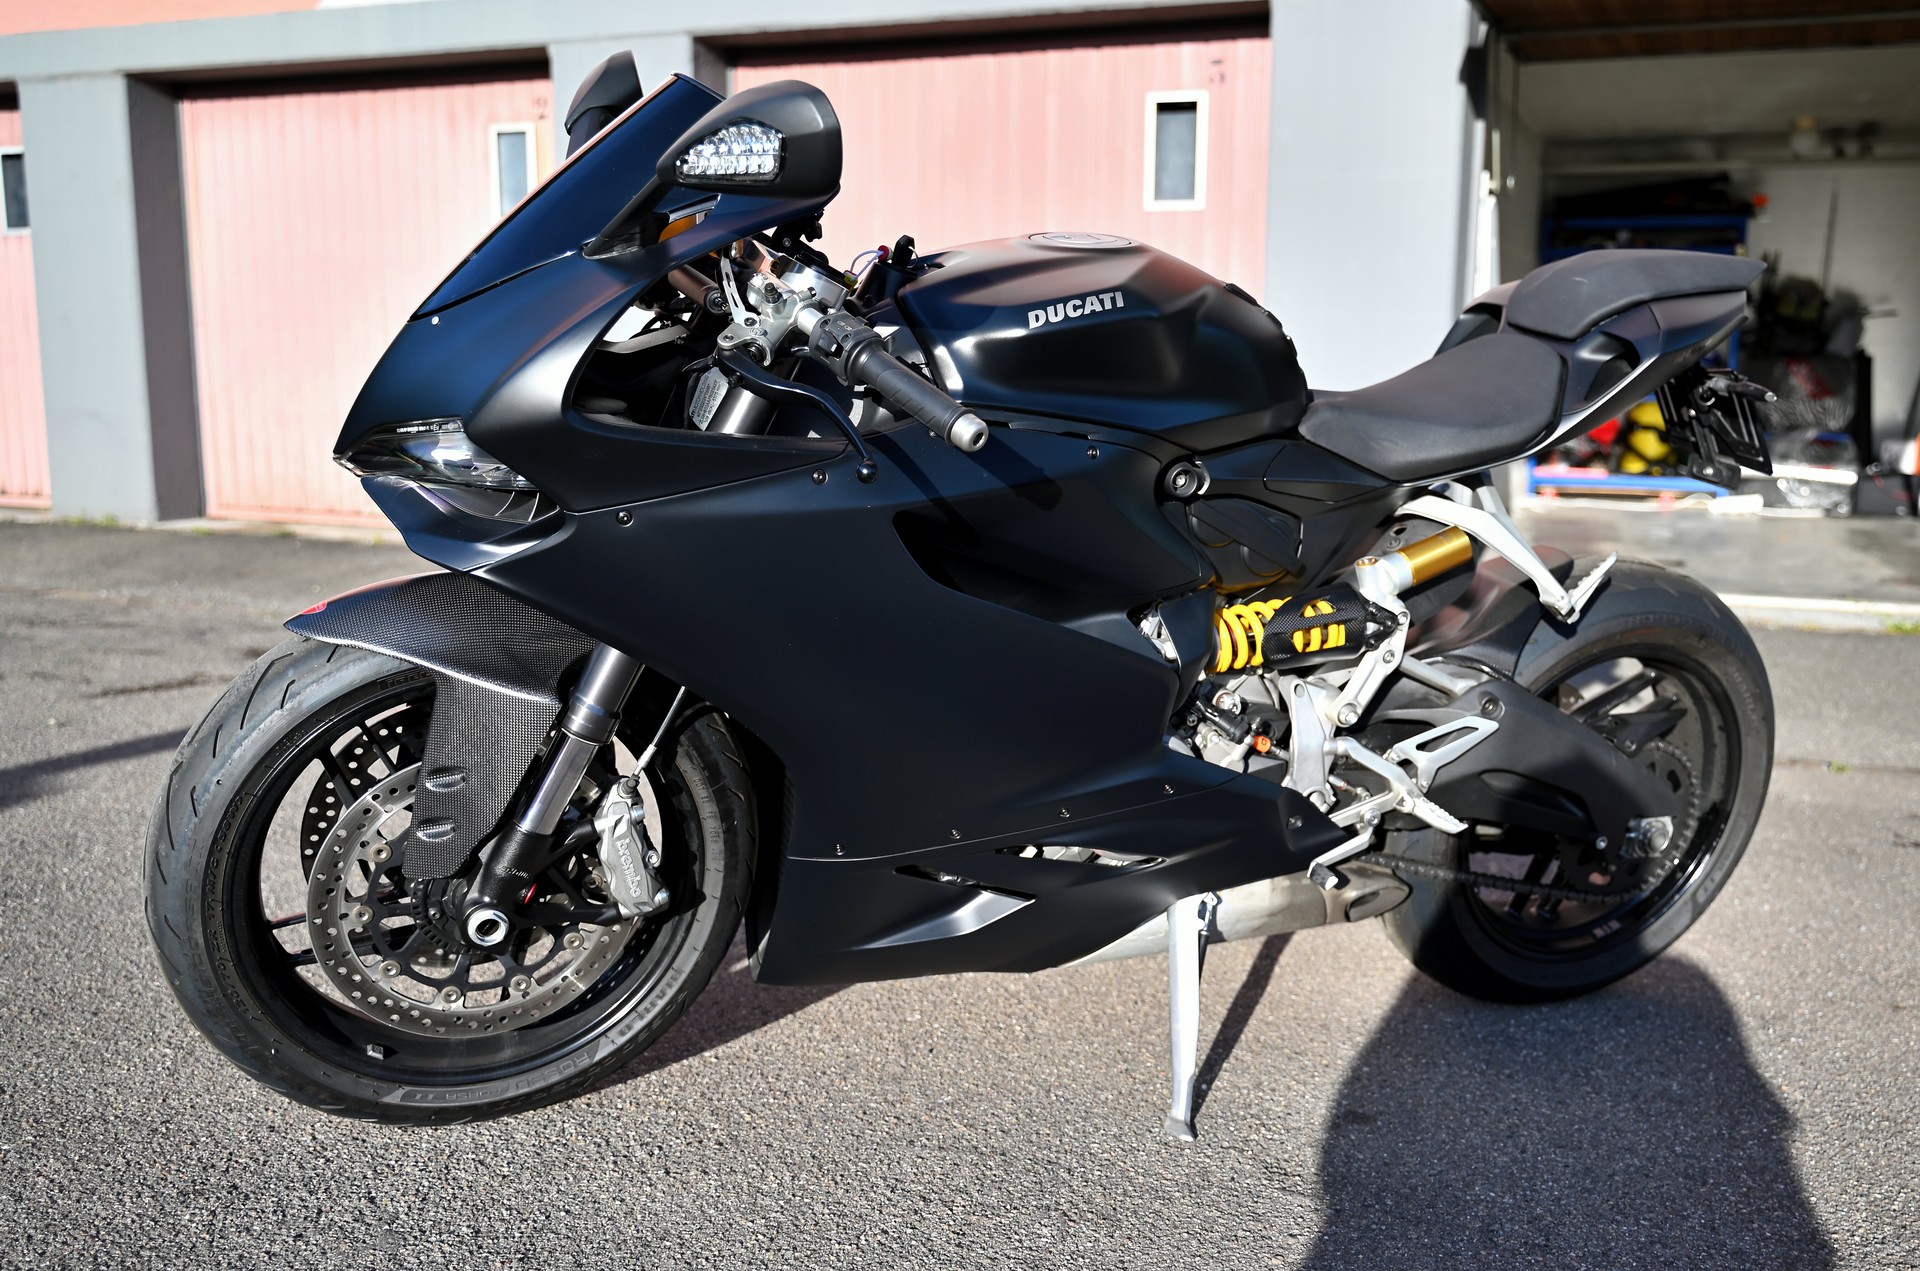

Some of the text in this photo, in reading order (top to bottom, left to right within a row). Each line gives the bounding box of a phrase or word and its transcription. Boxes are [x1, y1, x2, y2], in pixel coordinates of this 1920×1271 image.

[1027, 291, 1125, 330] DUCATI
[616, 837, 642, 898] brembo
[205, 901, 215, 921] 17
[208, 929, 220, 953] ZR
[619, 968, 684, 1038] DIABLO
[515, 1052, 590, 1090] ROSSO
[446, 1087, 502, 1101] CORSA
